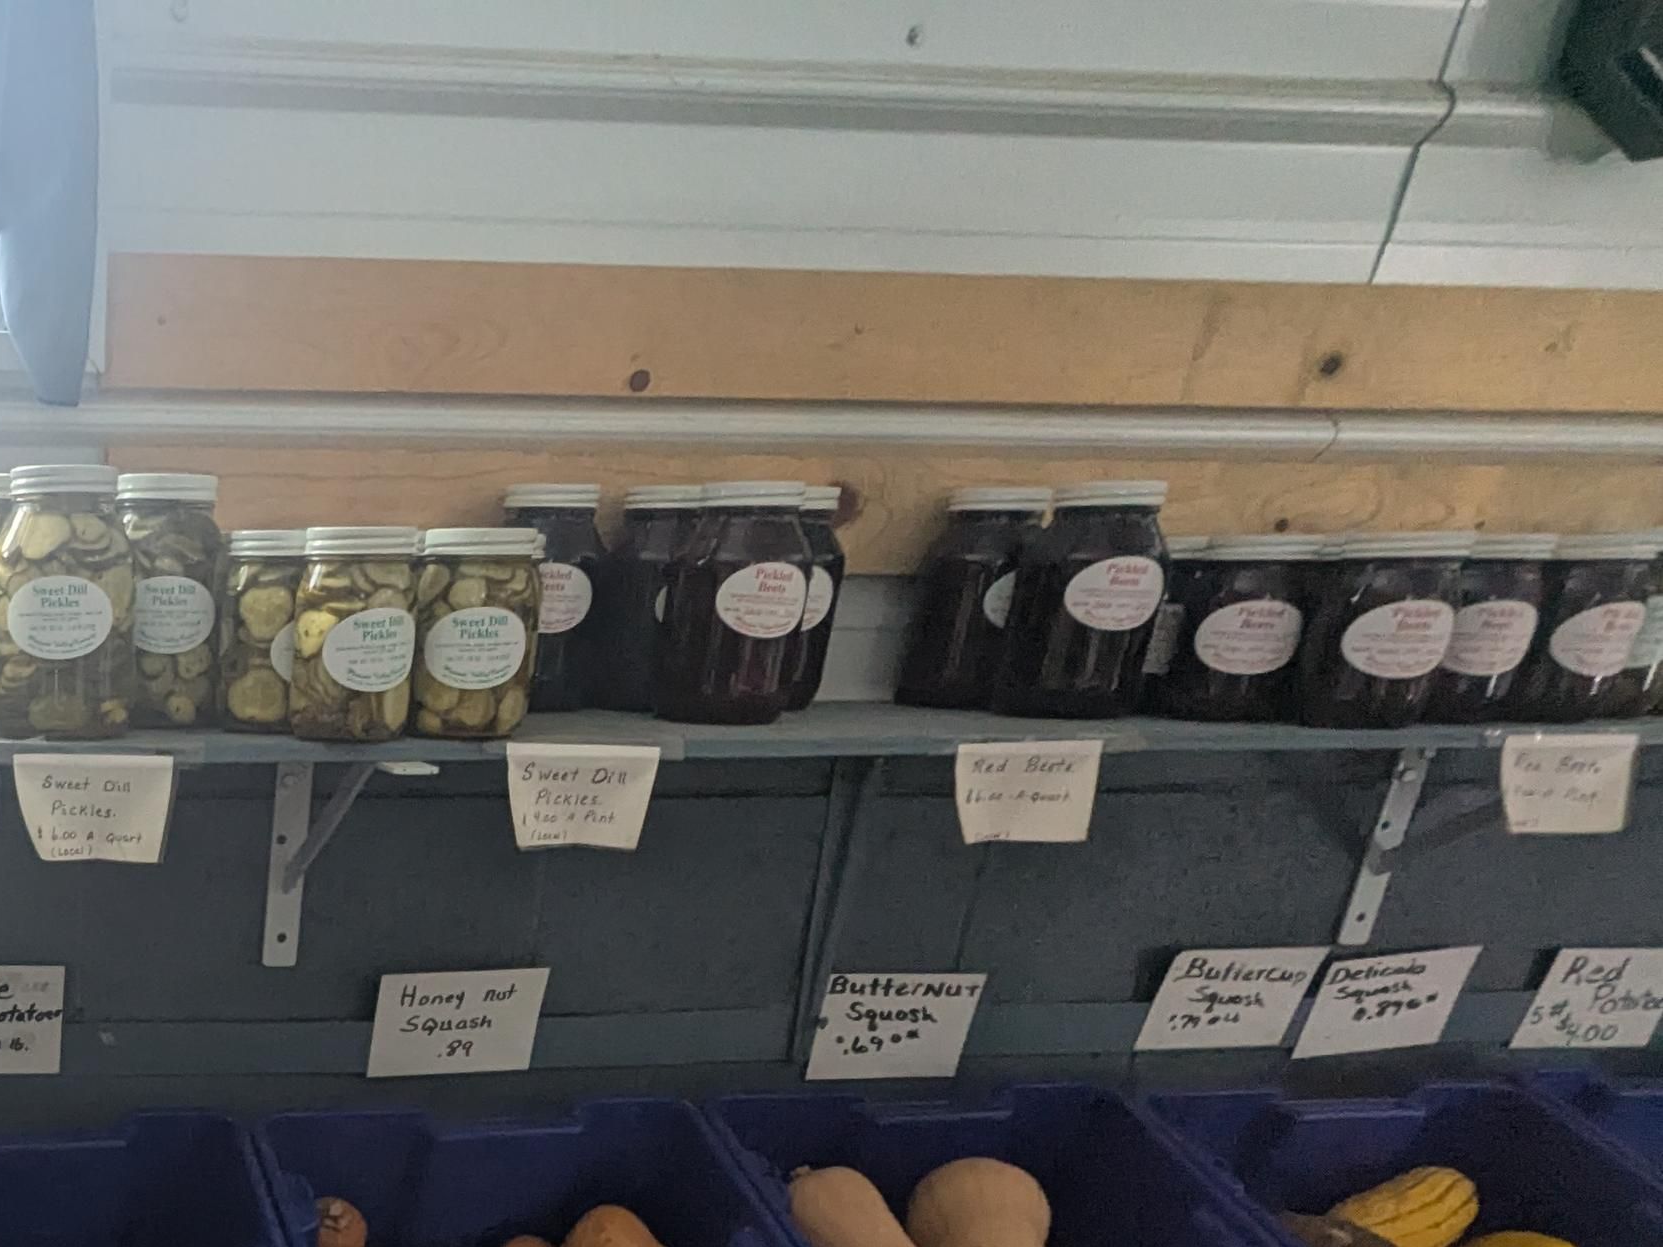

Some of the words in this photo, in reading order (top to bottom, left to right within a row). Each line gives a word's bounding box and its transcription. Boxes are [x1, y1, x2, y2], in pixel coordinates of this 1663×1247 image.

[452, 616, 486, 628] Sweet
[488, 615, 508, 627] Dill
[459, 627, 499, 640] Pickles
[42, 774, 90, 791] Sweet
[103, 779, 131, 793] Dill
[522, 761, 579, 781] Sweet
[592, 767, 627, 785] Dill
[1562, 956, 1631, 985] Red
[400, 984, 466, 1010] Honey
[483, 983, 518, 1003] nut
[1188, 986, 1265, 1014] Squash
[1334, 980, 1413, 1004] Squash
[399, 1015, 492, 1036] Squash
[846, 1001, 938, 1032] Squash
[437, 1039, 475, 1059] .89
